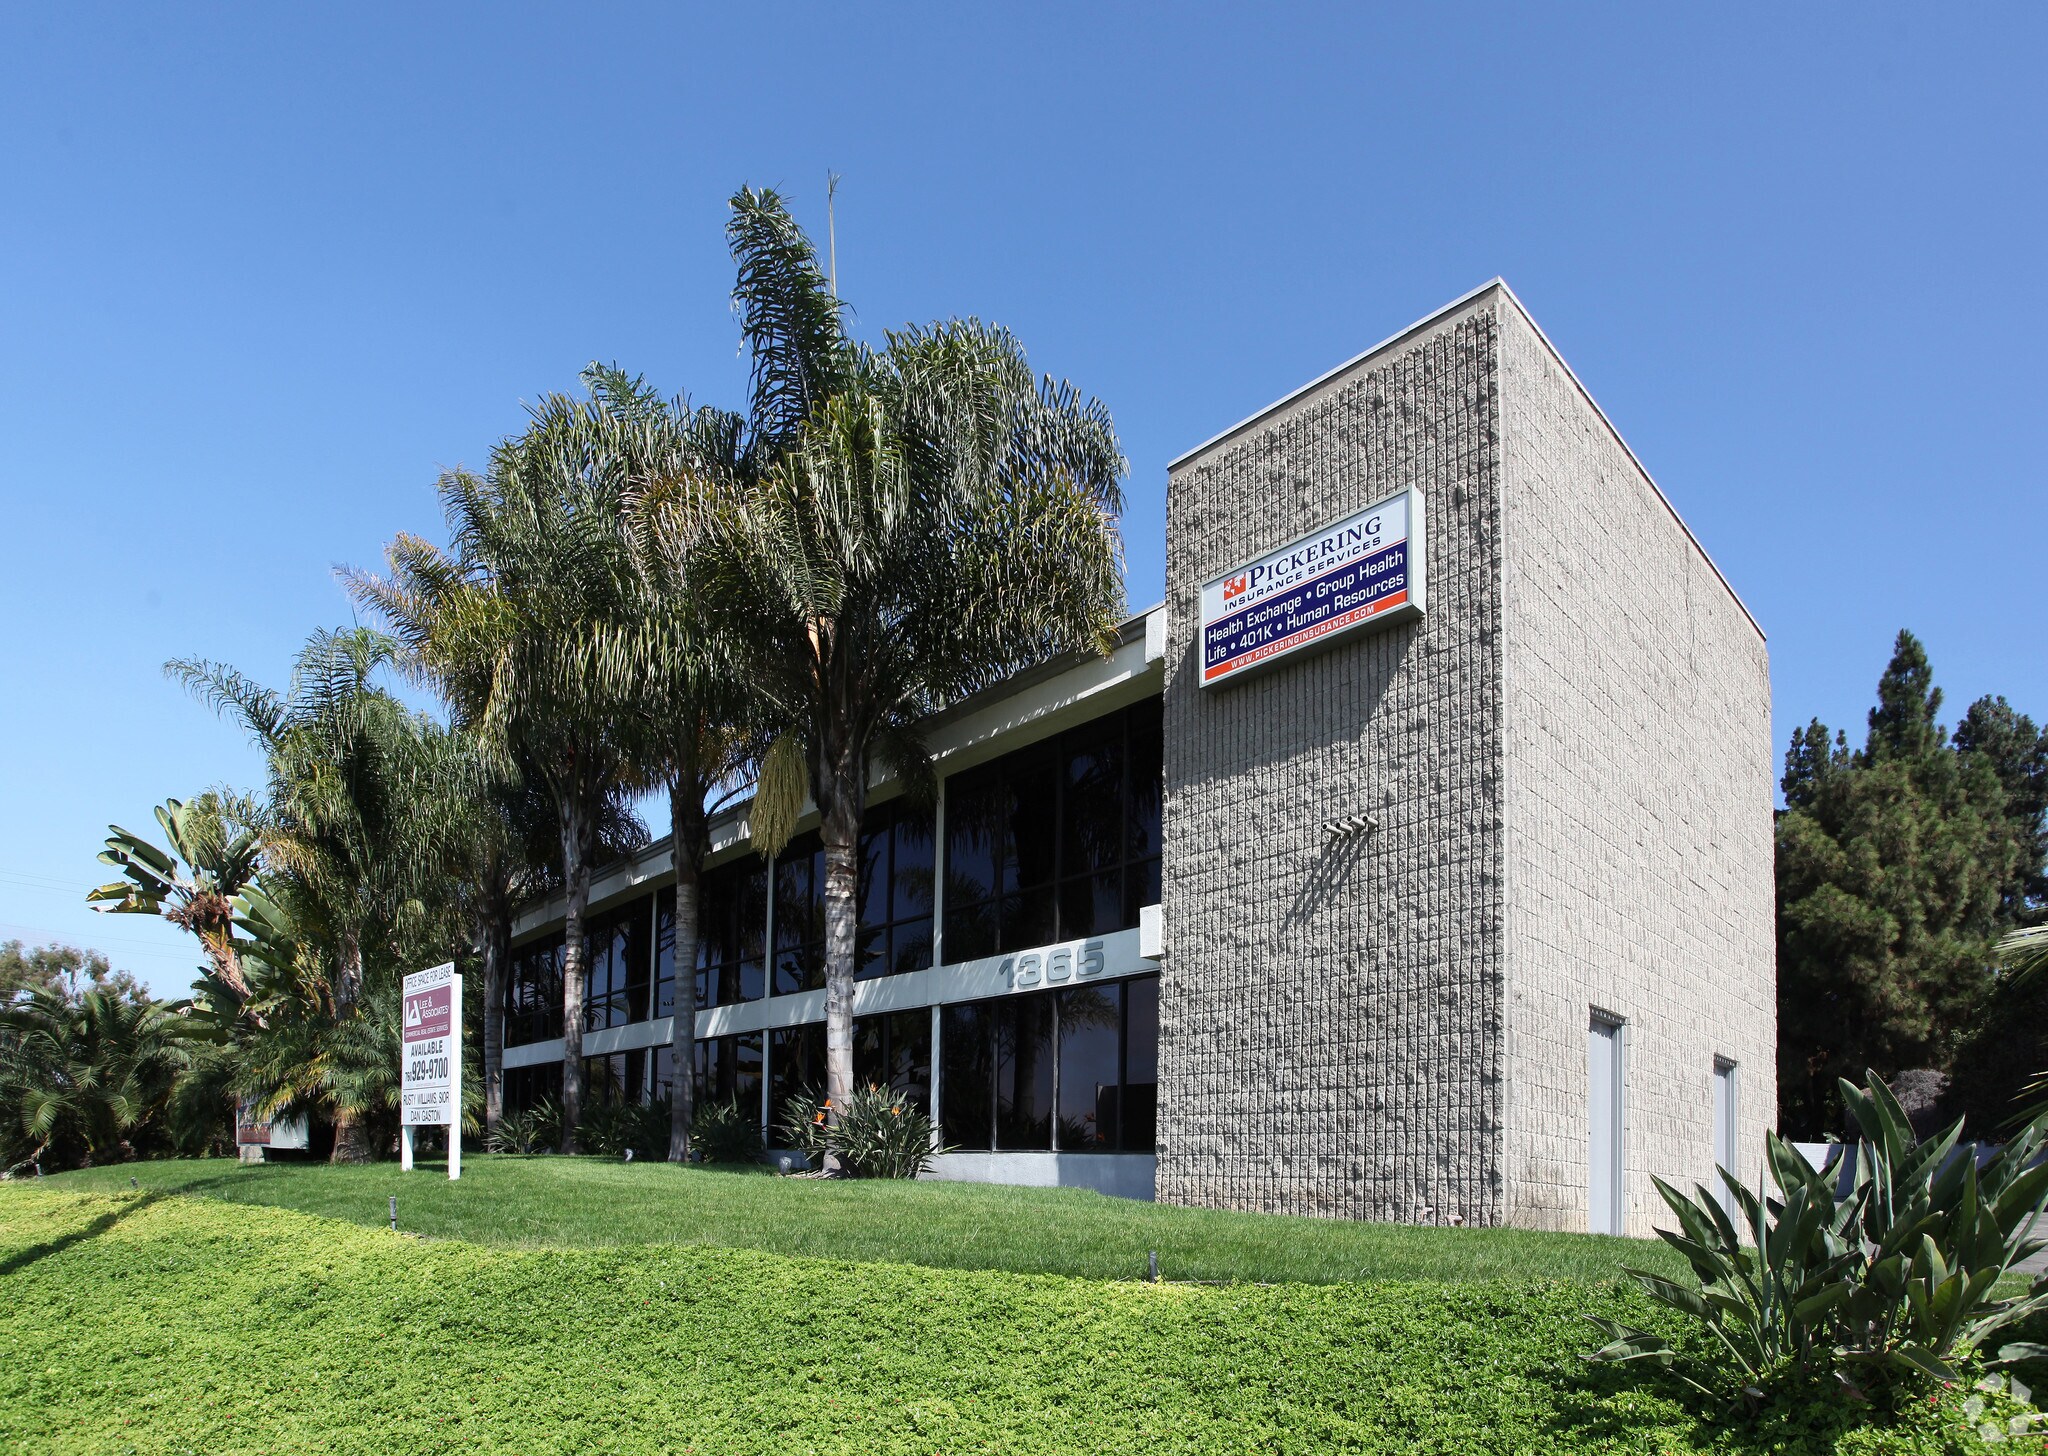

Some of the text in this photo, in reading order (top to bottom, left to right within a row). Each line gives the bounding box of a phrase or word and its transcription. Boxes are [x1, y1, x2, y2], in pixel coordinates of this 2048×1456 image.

[1249, 516, 1382, 590] PICKERING
[1224, 536, 1381, 612] INSURANCE SERVICES
[1208, 550, 1403, 645] Health Exchange Group Health
[1208, 573, 1404, 663] Life 401K Human Resources
[1231, 605, 1375, 669] WWW.PICKERINGINSURANCE.COM
[418, 972, 429, 987] SPACE
[430, 969, 438, 983] FOR
[439, 965, 451, 980] LEASE
[998, 941, 1105, 988] 1365
[420, 999, 428, 1010] LEE
[422, 1005, 449, 1019] ASSOCIATES
[411, 1039, 443, 1058] AVAILABLE
[412, 1057, 448, 1081] 929-9700
[403, 1094, 416, 1106] RUSTY
[410, 1109, 441, 1122] DAN GASTON
